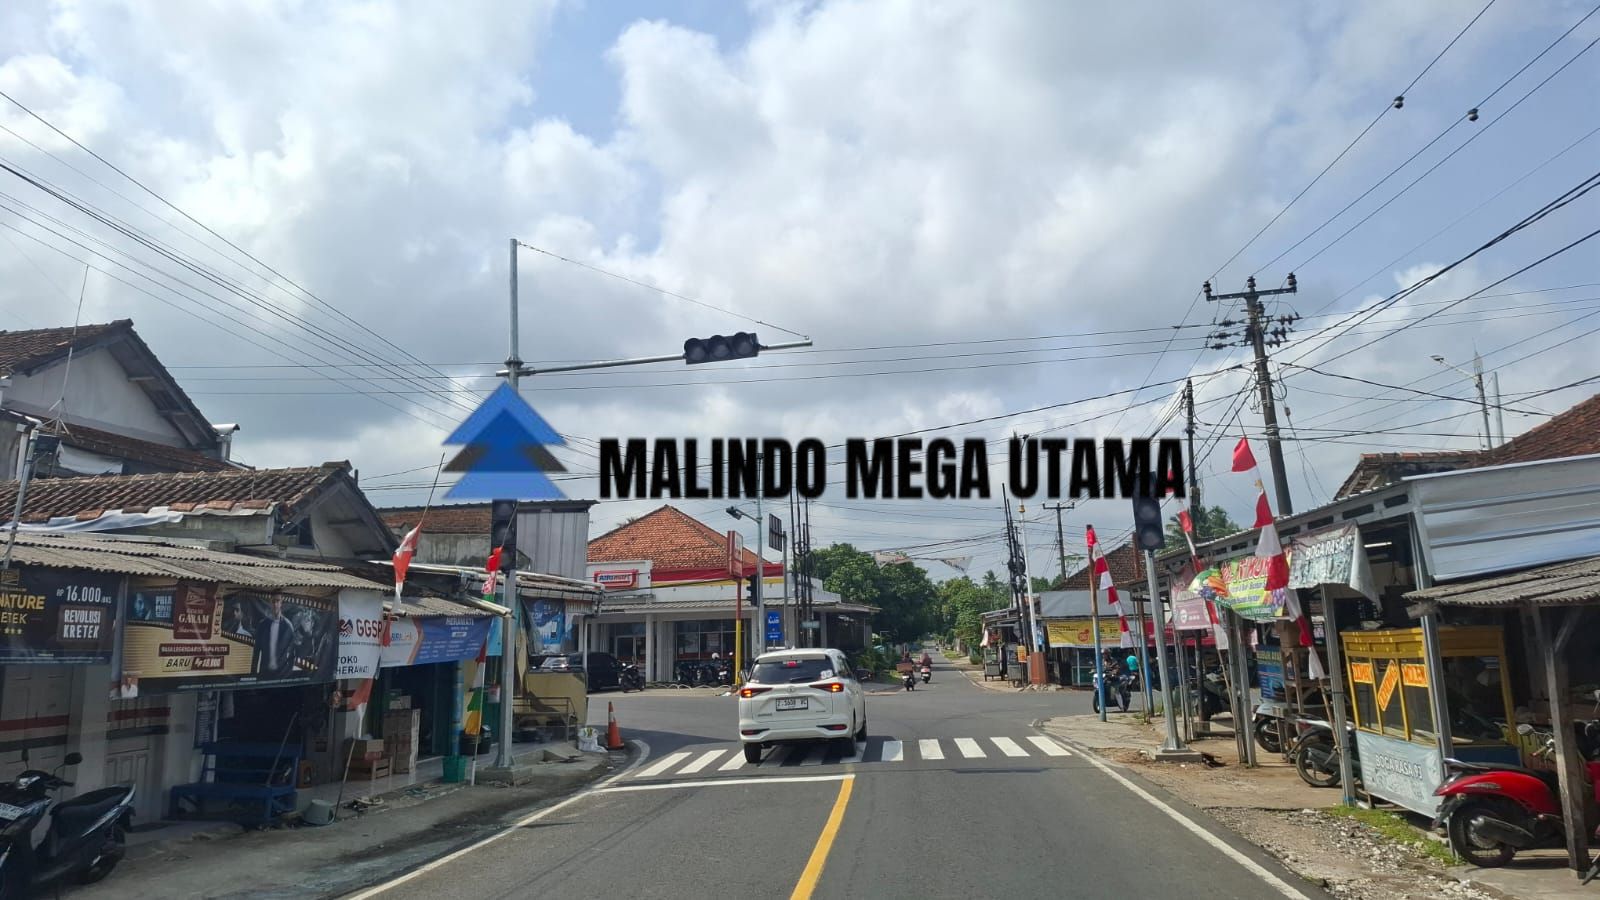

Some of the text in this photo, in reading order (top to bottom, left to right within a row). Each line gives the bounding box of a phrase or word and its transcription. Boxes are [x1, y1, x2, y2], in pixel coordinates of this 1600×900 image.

[66, 585, 102, 602] 16.000
[64, 609, 101, 623] REVOLUSI
[178, 613, 210, 624] GARAM
[63, 624, 100, 639] KRETEK
[166, 658, 191, 668] BARU
